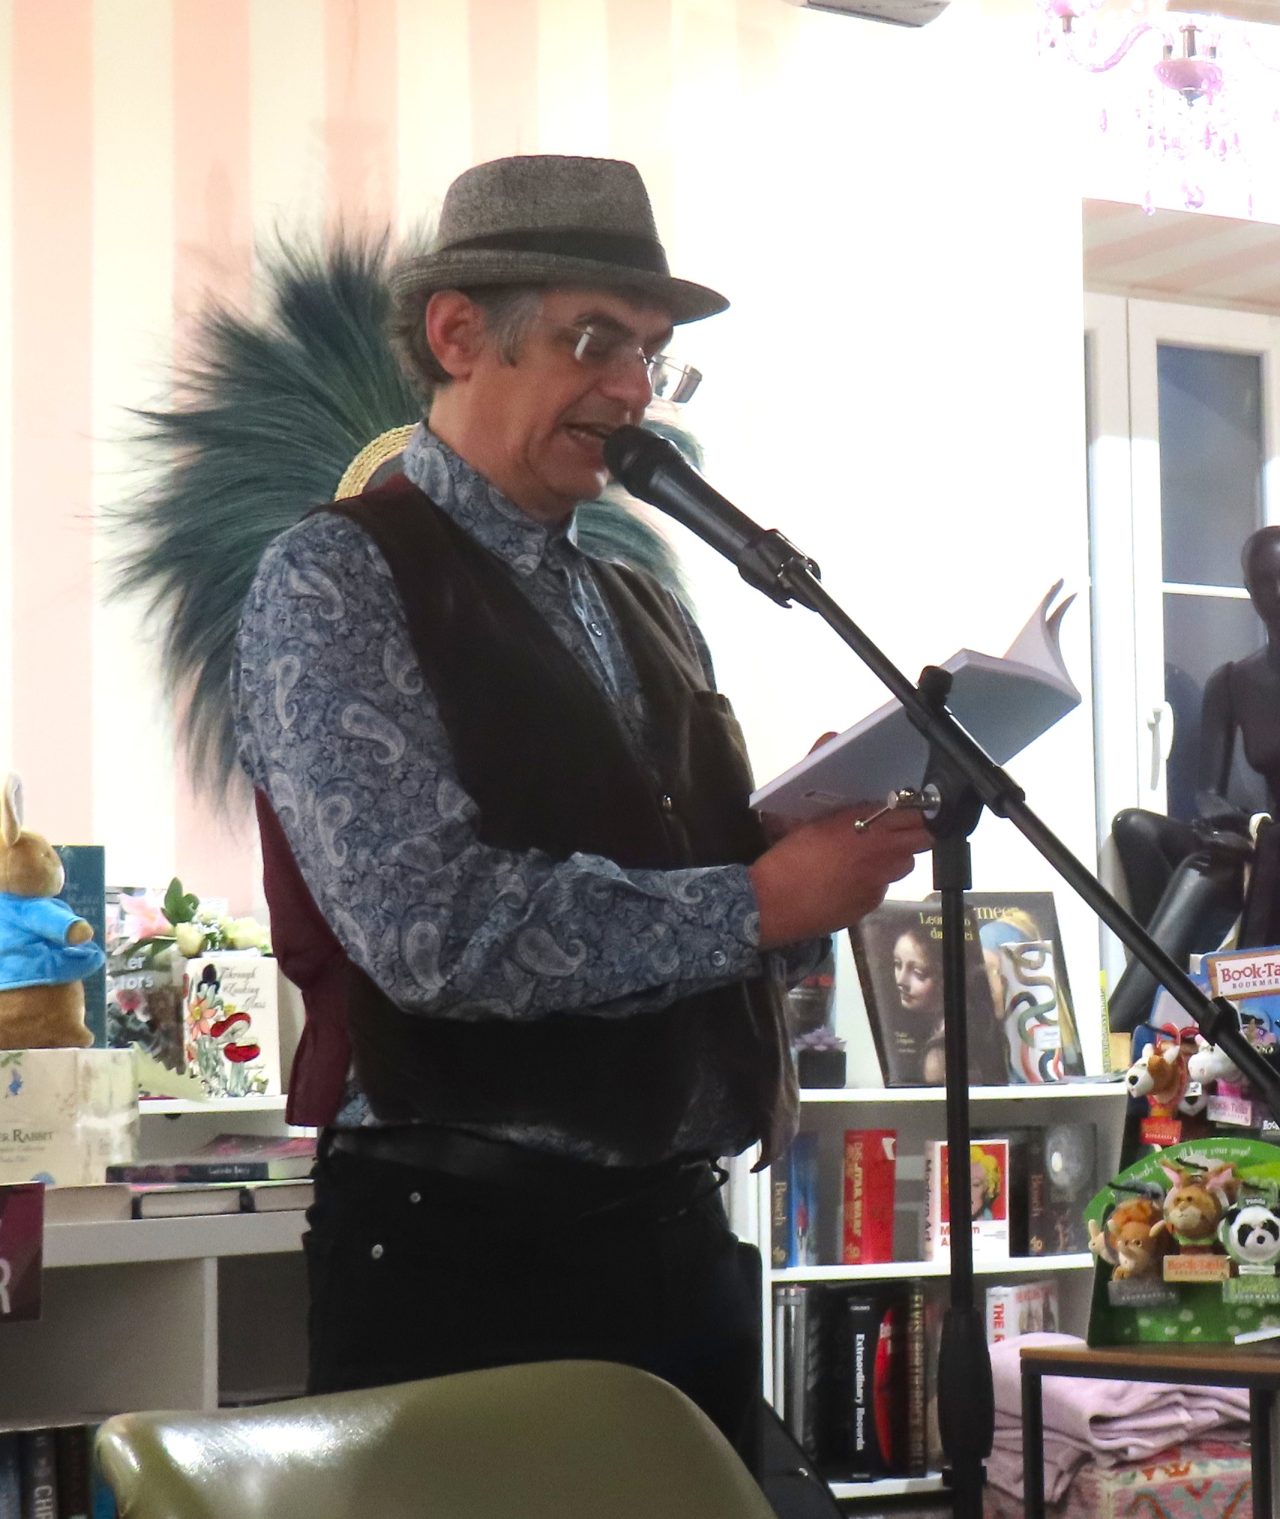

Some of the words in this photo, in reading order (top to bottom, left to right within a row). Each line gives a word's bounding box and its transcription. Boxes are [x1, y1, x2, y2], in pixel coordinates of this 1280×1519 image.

[13, 1129, 54, 1143] RABBIT
[1210, 1146, 1228, 1156] your
[774, 1181, 786, 1226] Bosch
[1031, 1174, 1043, 1217] Bosch
[993, 1303, 1005, 1329] THE
[855, 1333, 865, 1406] Extraordinary
[855, 1407, 865, 1450] Records
